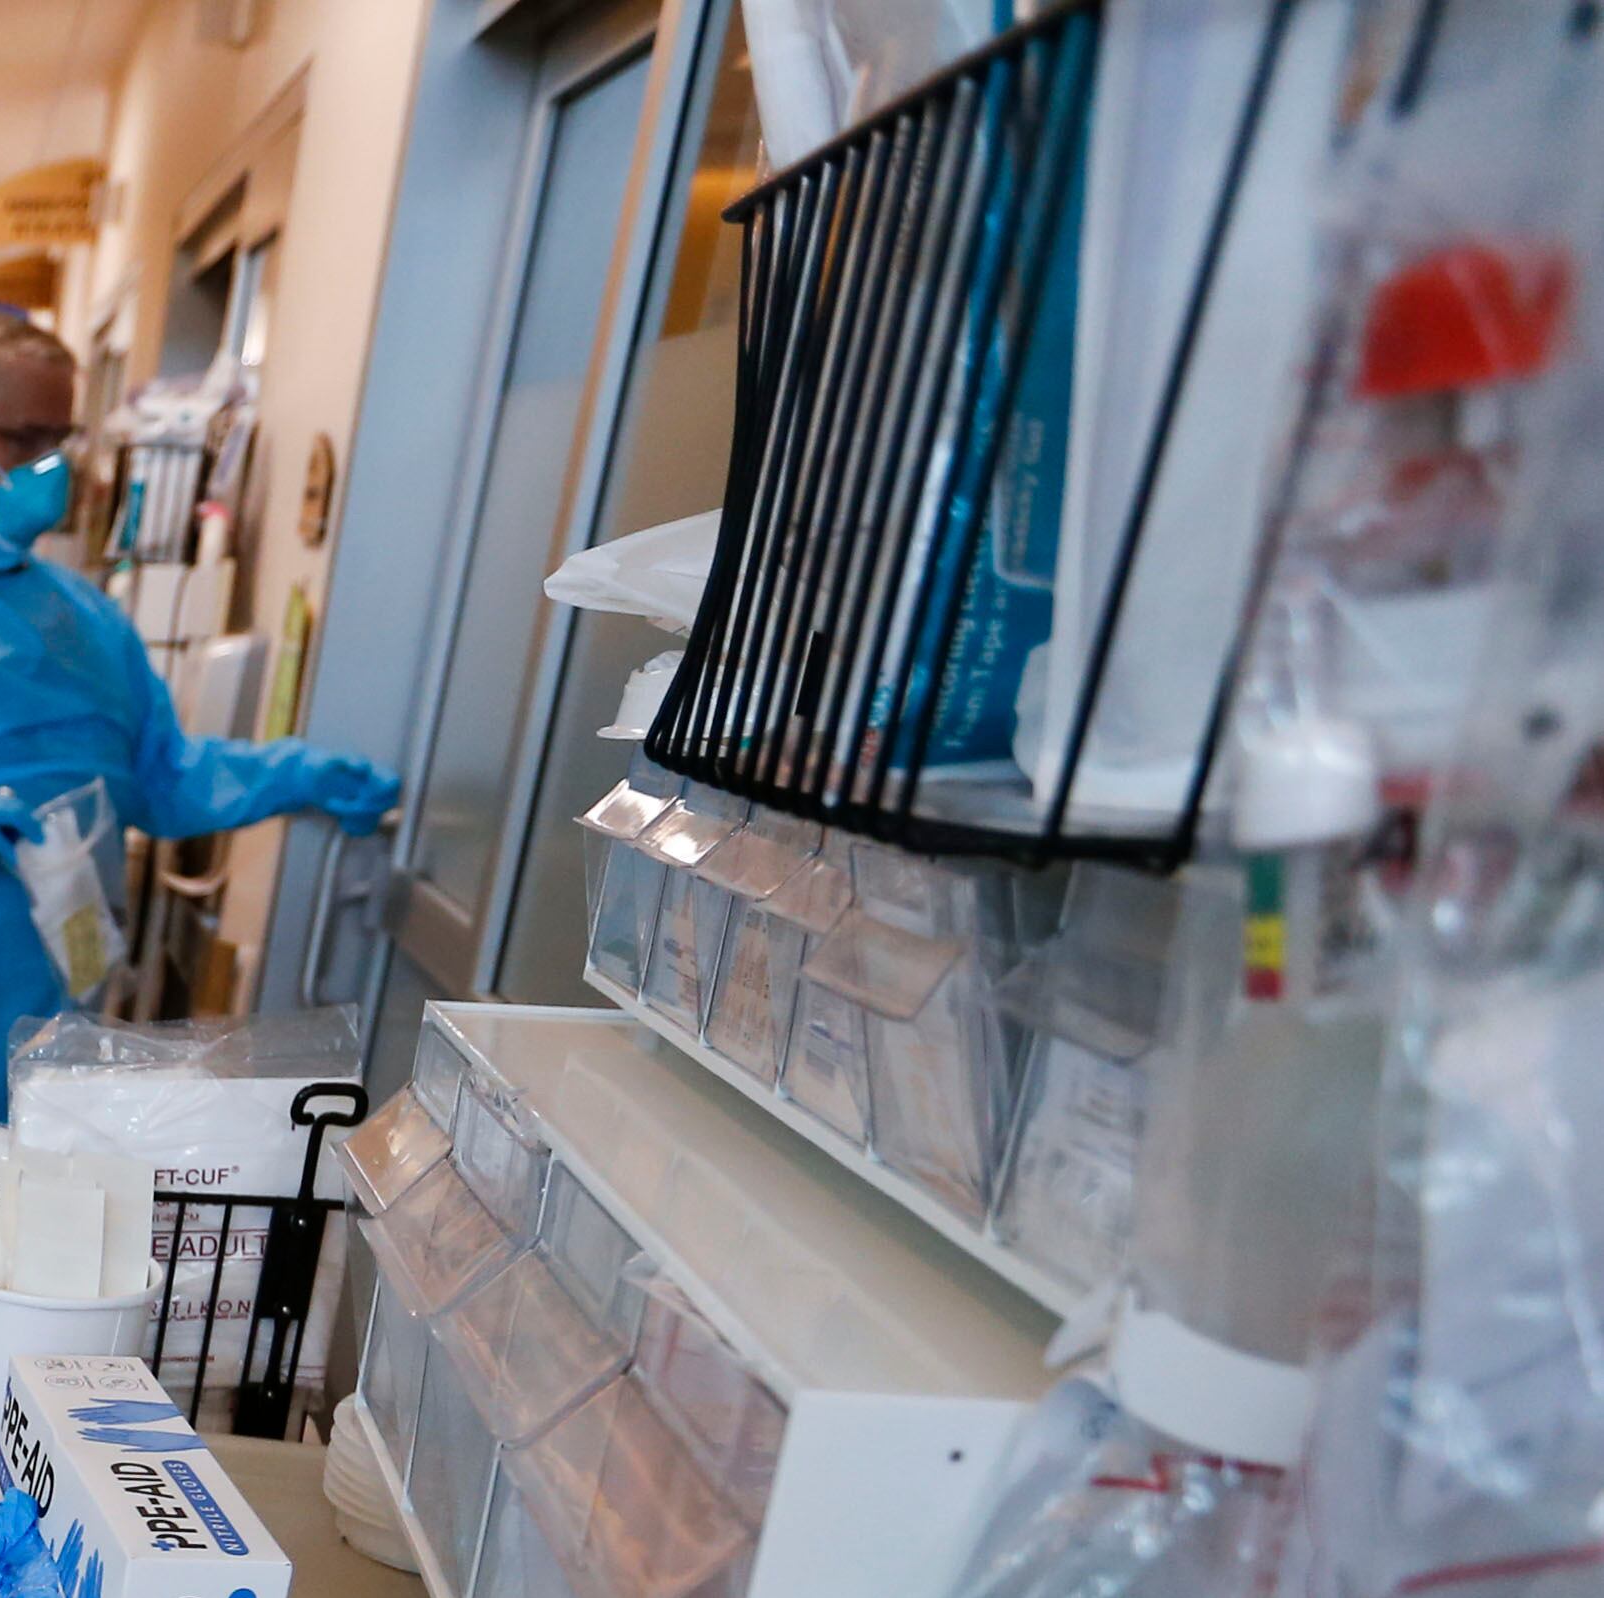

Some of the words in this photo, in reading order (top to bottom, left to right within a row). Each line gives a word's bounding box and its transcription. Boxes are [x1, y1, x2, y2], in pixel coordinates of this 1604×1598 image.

[179, 1235, 269, 1256] ADULT
[168, 1462, 208, 1502] GLOVES
[110, 1462, 208, 1549] PPE-AID
[199, 1505, 243, 1552] NITRILE
